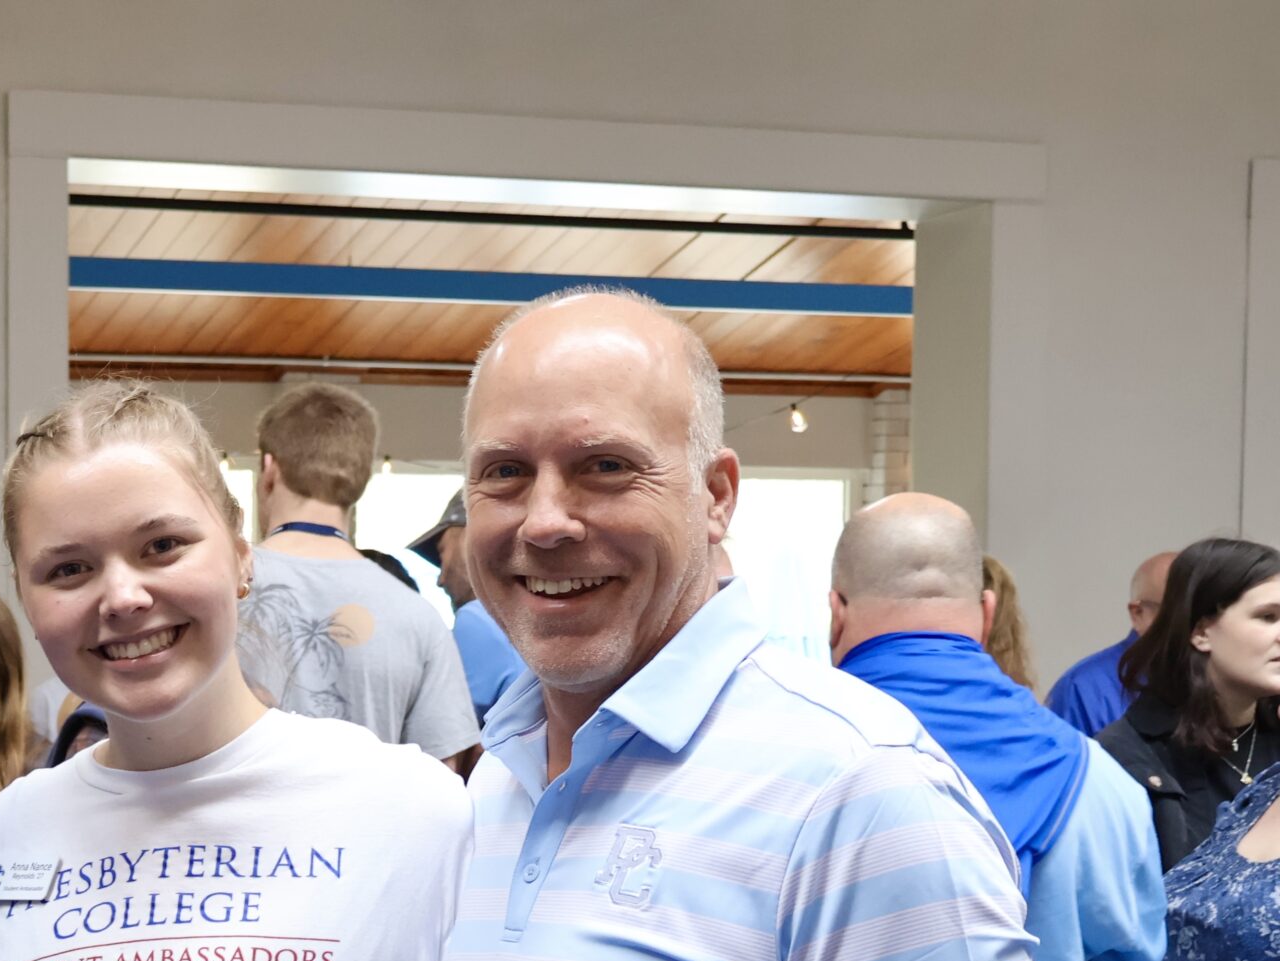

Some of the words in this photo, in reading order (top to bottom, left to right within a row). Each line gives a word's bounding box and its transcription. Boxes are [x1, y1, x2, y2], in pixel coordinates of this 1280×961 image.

[6, 844, 345, 919] ESBYTERIAN
[593, 820, 663, 909] PC
[52, 891, 262, 940] COLLEGE
